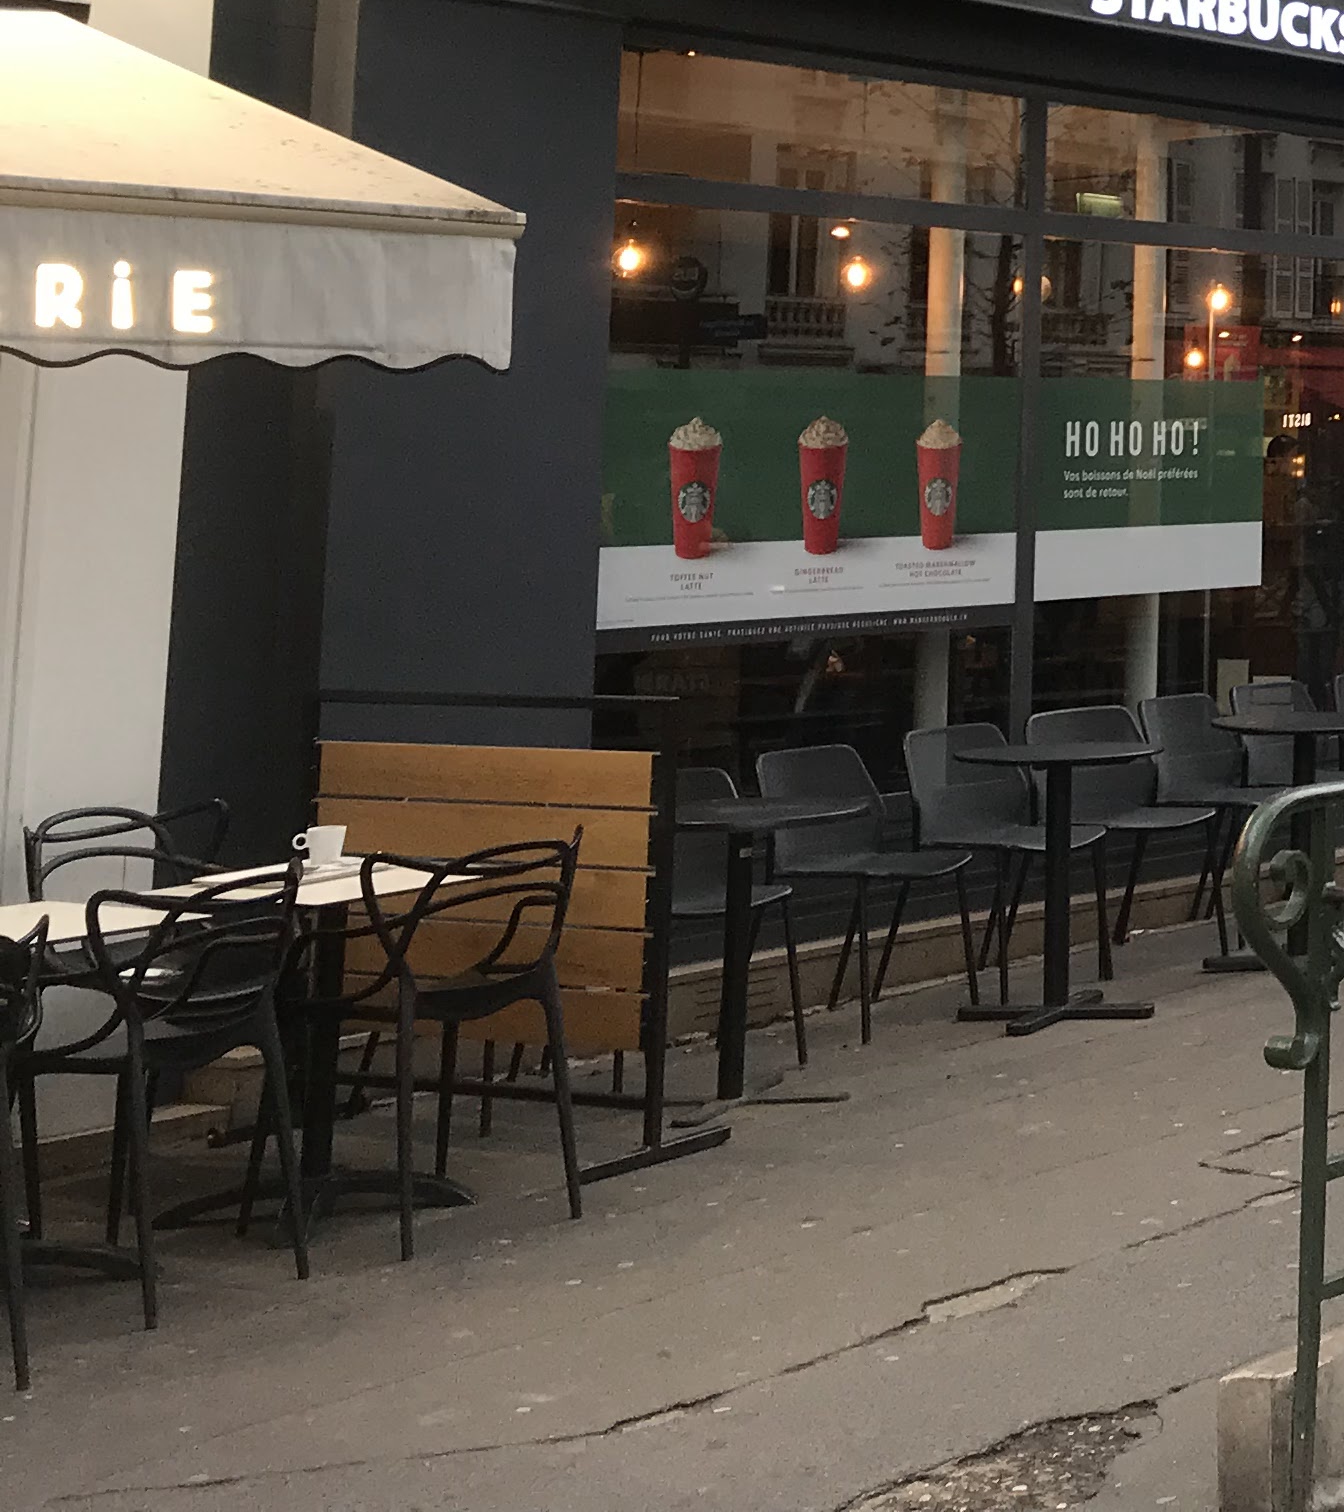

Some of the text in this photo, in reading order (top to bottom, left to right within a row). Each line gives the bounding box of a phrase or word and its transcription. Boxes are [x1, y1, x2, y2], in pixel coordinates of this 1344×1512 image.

[1065, 420, 1099, 457] HO
[1110, 420, 1143, 457] HO
[1063, 467, 1198, 481] Vos boissons de Noël préférées
[1063, 488, 1083, 499] sont
[1085, 487, 1097, 498] de
